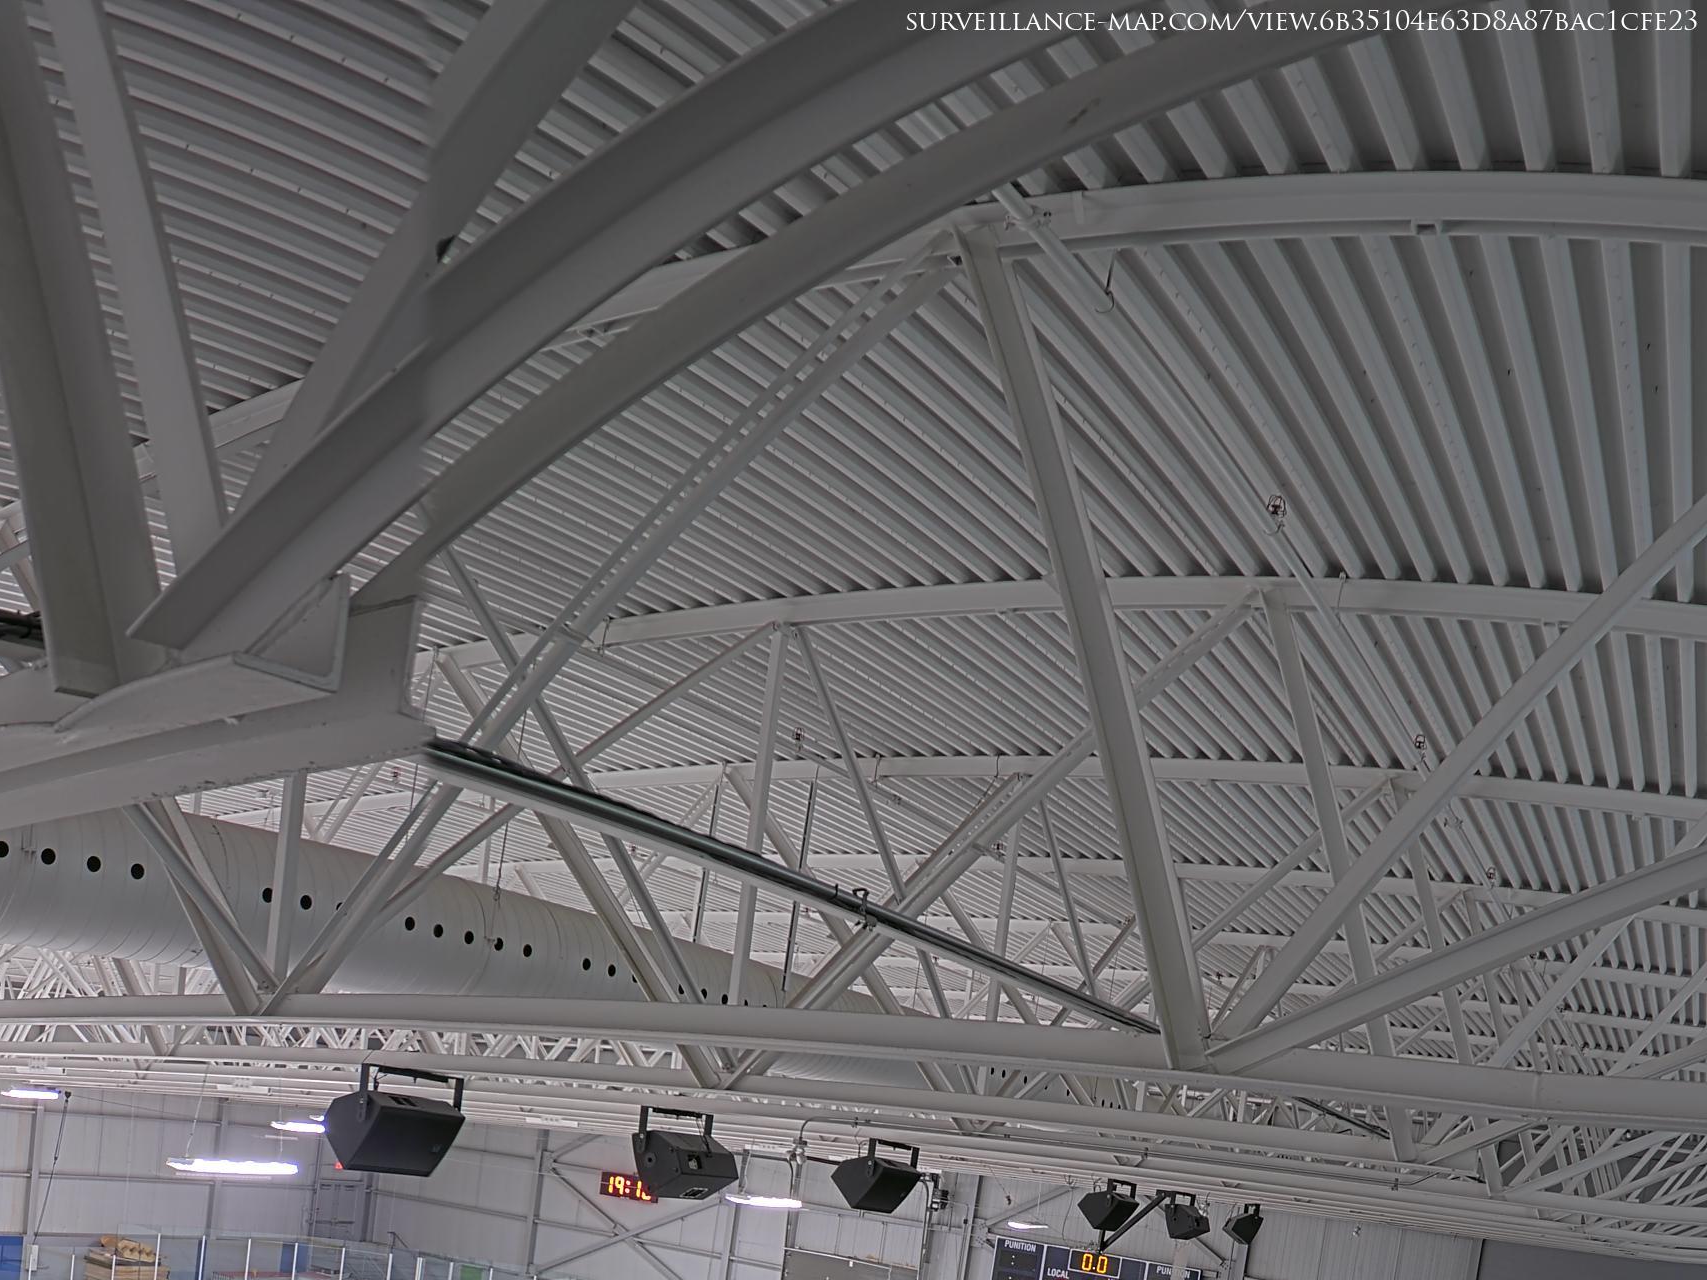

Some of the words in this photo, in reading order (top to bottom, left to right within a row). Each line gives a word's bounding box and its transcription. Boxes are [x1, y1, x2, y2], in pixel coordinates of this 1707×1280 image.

[1004, 1239, 1037, 1253] PUNITION
[1081, 1253, 1108, 1274] 0.0
[1047, 1268, 1070, 1280] LOCAL
